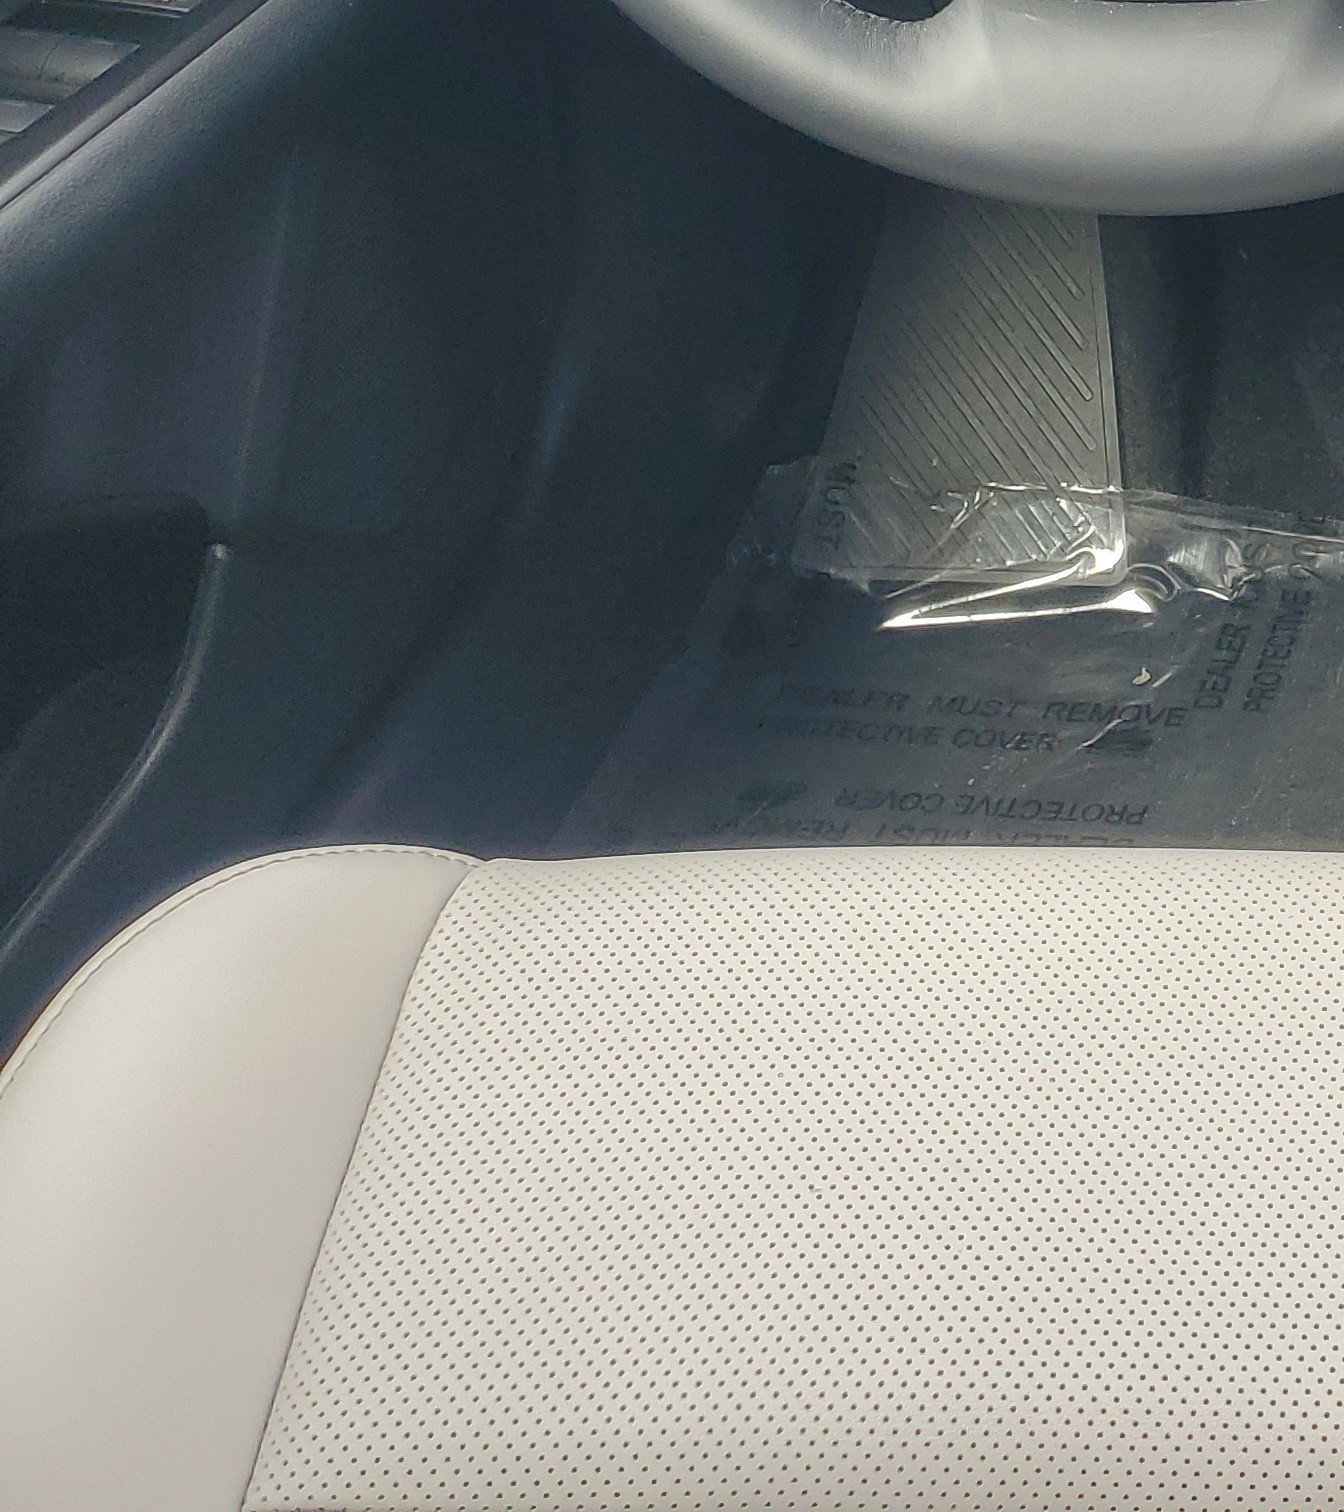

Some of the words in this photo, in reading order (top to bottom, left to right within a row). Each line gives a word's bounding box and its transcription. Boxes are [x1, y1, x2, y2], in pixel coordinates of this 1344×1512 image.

[1193, 621, 1252, 711] DEALER
[925, 693, 1027, 719] MUST
[1041, 699, 1188, 729] REMOVE
[951, 727, 1058, 753] COVER
[835, 786, 944, 815] COVER
[954, 793, 1149, 826] PROTECTIVE
